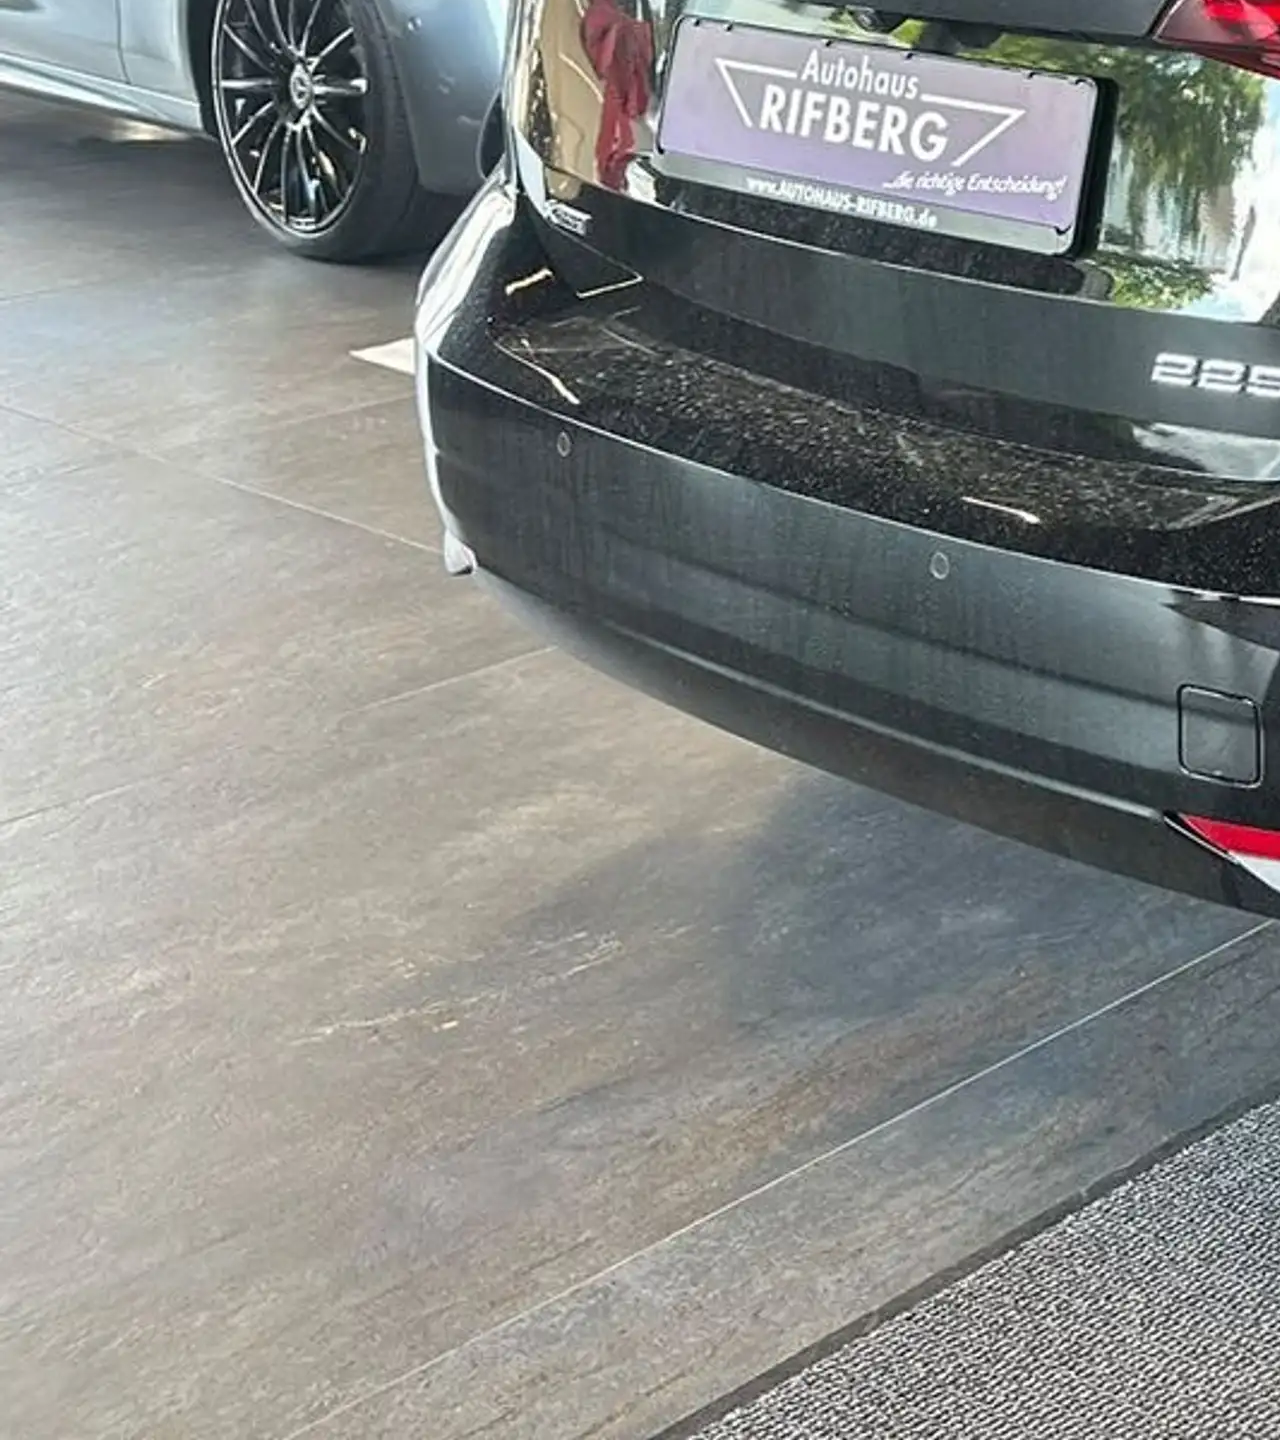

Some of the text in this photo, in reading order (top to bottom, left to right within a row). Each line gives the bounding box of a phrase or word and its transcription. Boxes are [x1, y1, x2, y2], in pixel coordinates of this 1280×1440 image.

[801, 48, 919, 100] Autohaus
[759, 83, 948, 162] RIFBERG
[746, 177, 938, 228] www.AUTOHAUS-RIFBERG.de
[915, 171, 965, 196] richtige
[967, 173, 1068, 201] Entscheidung!
